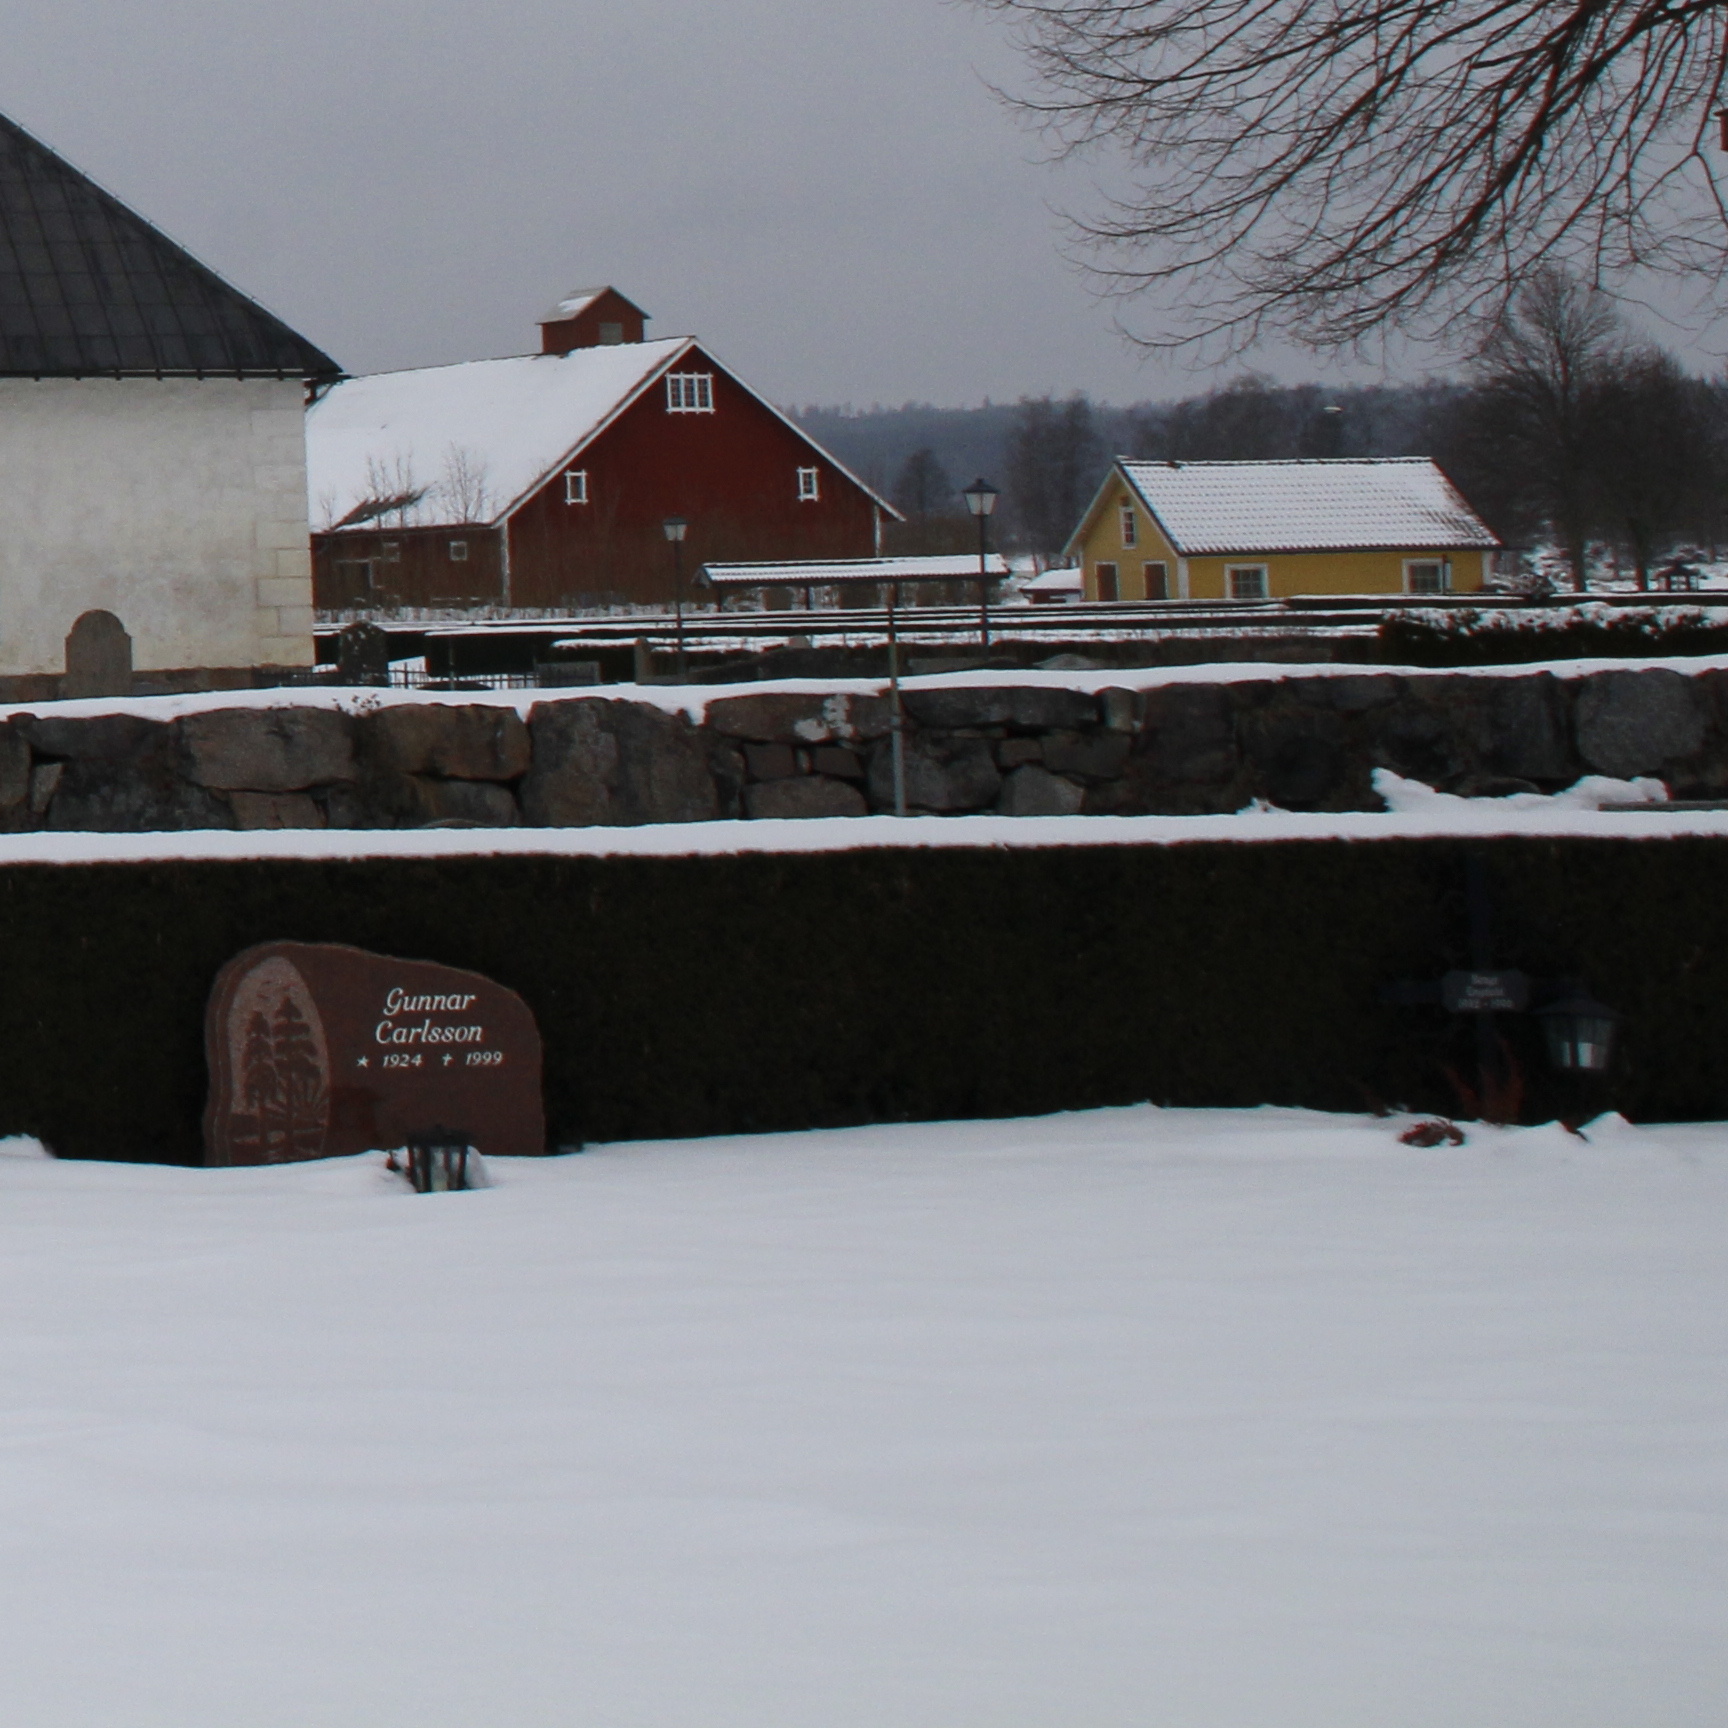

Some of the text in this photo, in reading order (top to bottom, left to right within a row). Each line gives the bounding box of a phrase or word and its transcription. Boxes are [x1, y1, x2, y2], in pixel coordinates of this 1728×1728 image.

[382, 986, 476, 1016] Gunnar
[375, 1018, 483, 1044] Carlsson
[382, 1051, 504, 1068] 1924 1999
